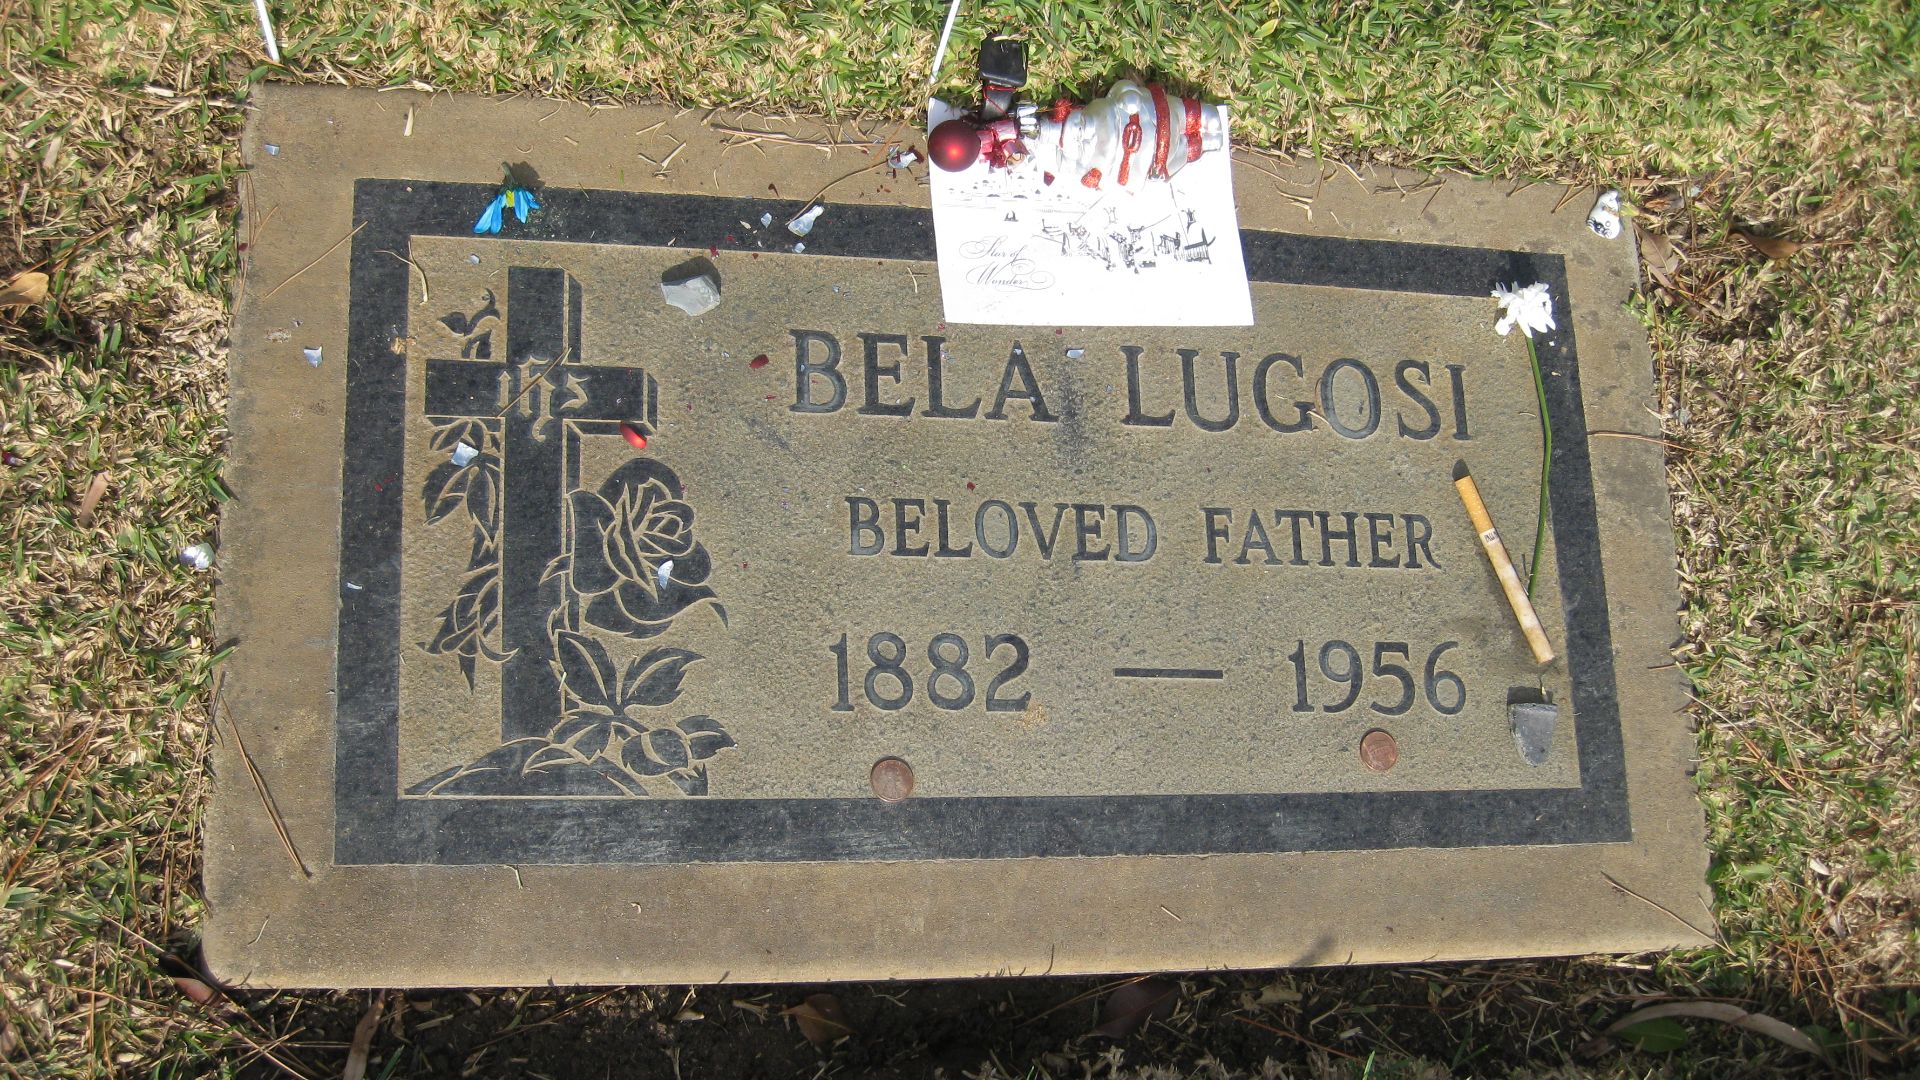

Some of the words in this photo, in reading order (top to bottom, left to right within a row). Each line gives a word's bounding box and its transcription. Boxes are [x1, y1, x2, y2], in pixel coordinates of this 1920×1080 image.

[958, 235, 1008, 259] Star
[1009, 244, 1029, 266] of
[965, 260, 1056, 292] Wonder
[788, 328, 1059, 423] BELA
[1119, 345, 1472, 441] LUGOSI
[845, 496, 1158, 562] BELOVED
[1200, 507, 1442, 570] FATHER
[829, 631, 1032, 712] 1882
[1288, 639, 1467, 716] 1956
